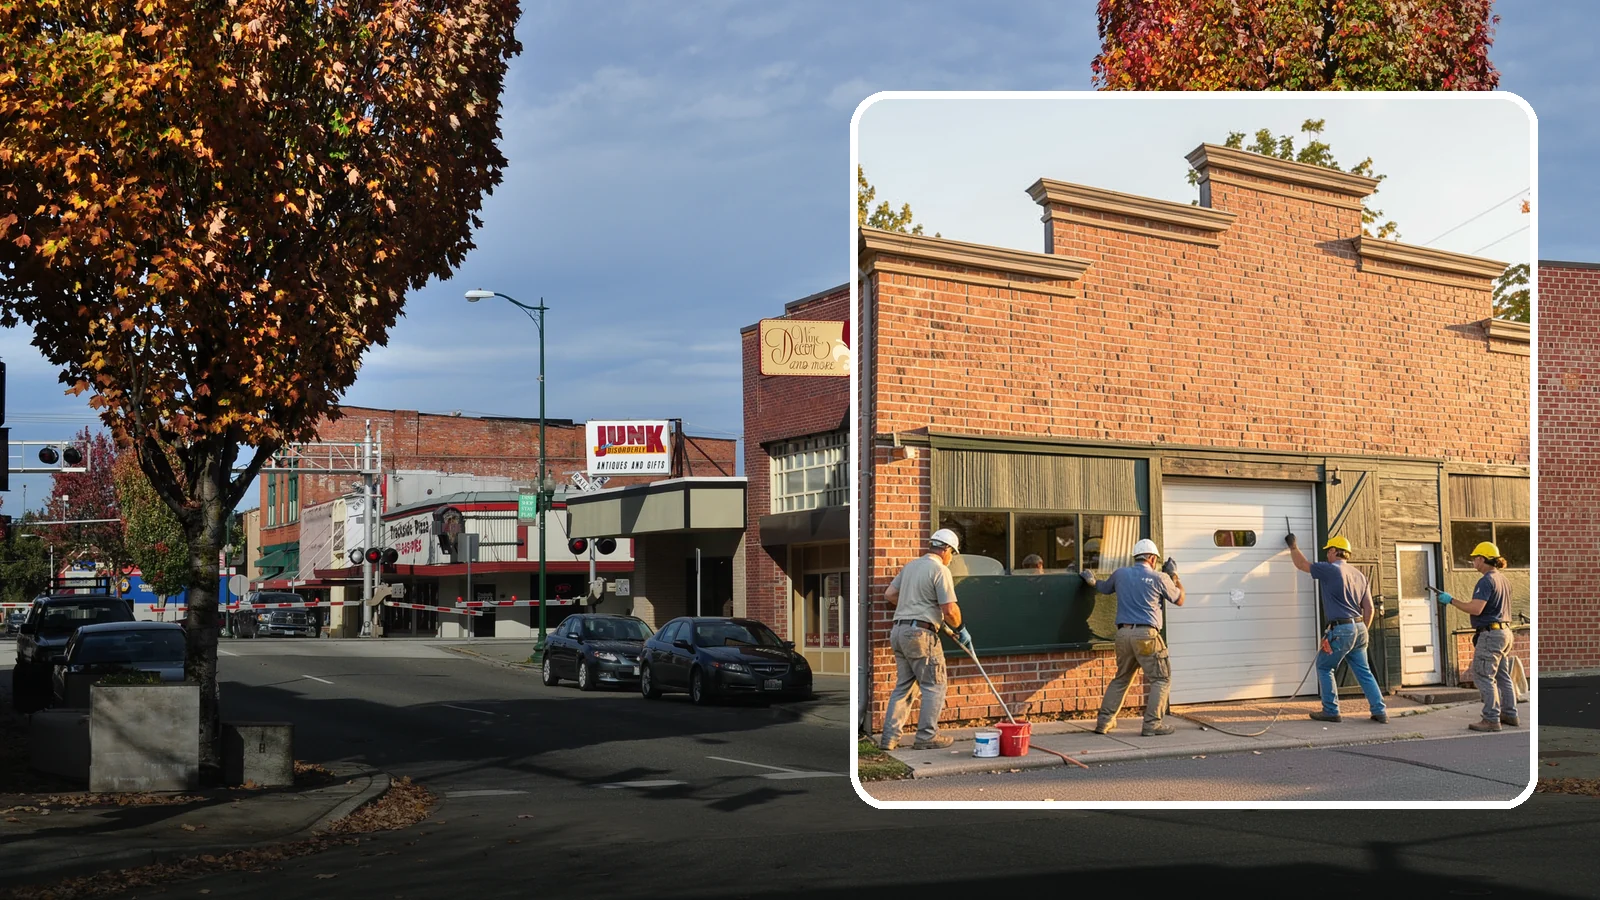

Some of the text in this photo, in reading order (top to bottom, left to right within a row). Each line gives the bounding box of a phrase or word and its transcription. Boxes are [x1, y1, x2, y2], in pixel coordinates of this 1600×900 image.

[596, 425, 665, 457] JUNK
[607, 446, 645, 454] DISORDERLY
[597, 460, 665, 470] ANTIQUES AND GIFTS
[390, 519, 429, 540] Trackside Pizza
